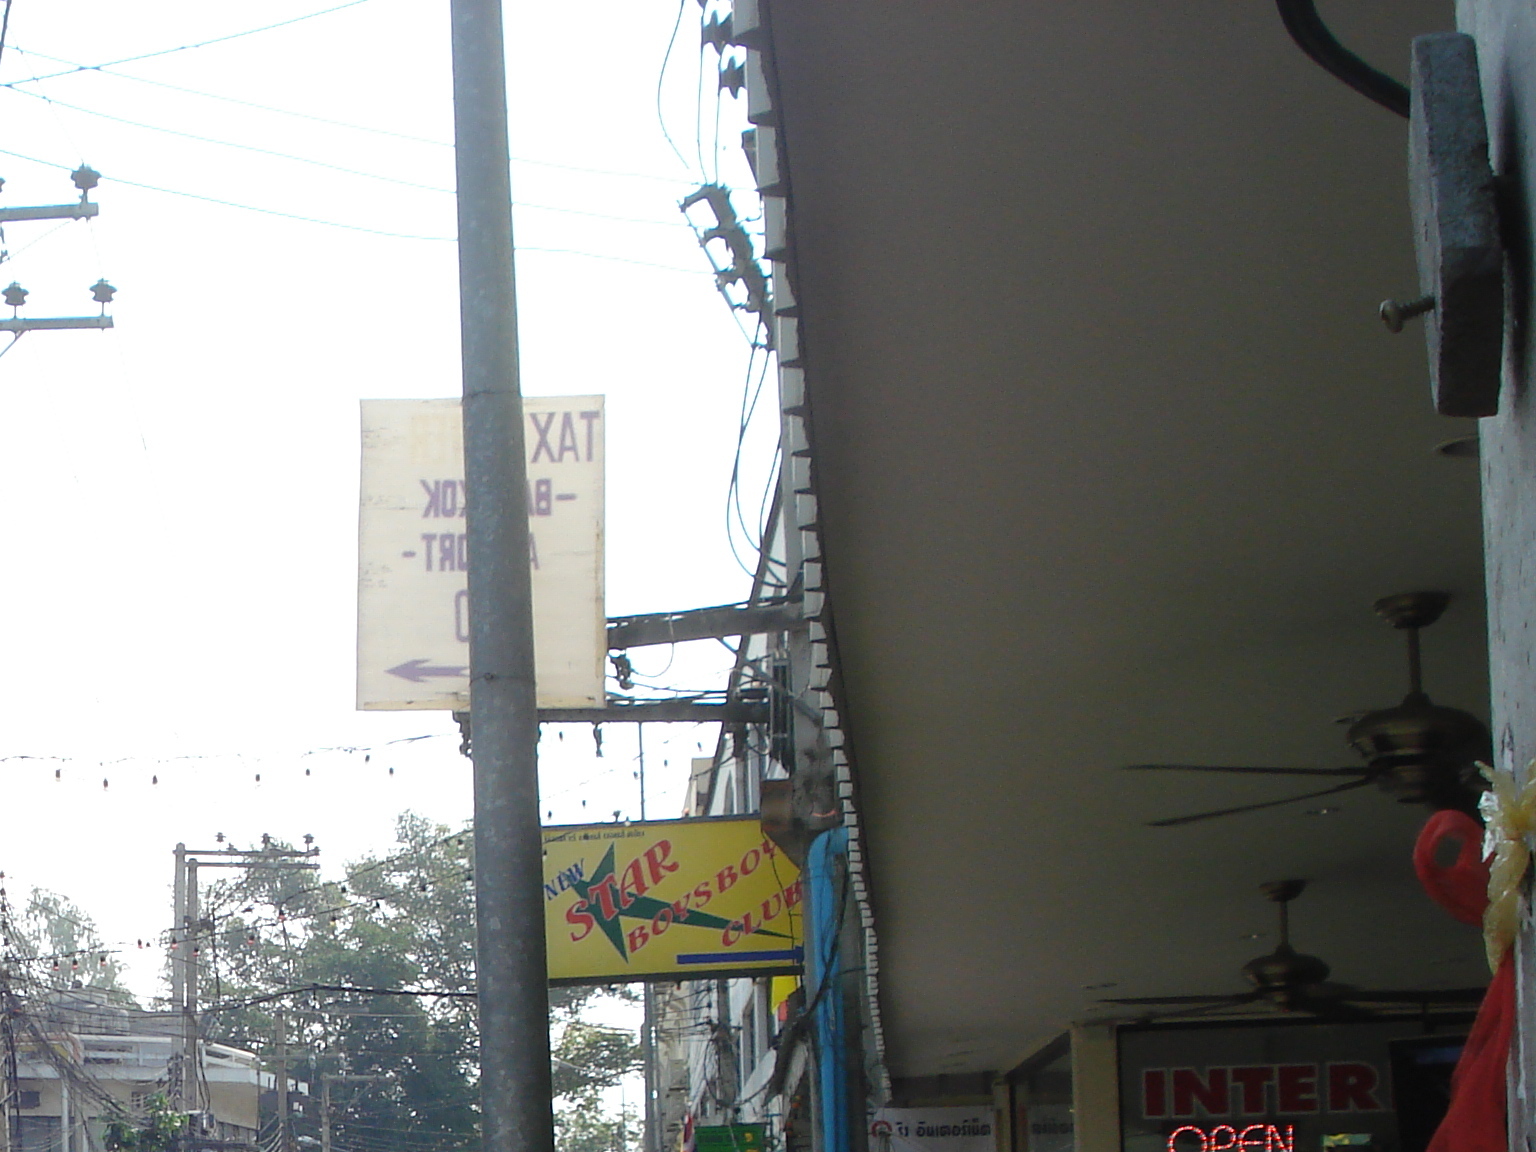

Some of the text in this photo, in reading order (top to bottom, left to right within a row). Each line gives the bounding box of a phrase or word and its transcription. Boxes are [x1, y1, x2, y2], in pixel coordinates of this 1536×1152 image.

[544, 839, 680, 943] NEW STAR
[1141, 1061, 1396, 1118] INTER
